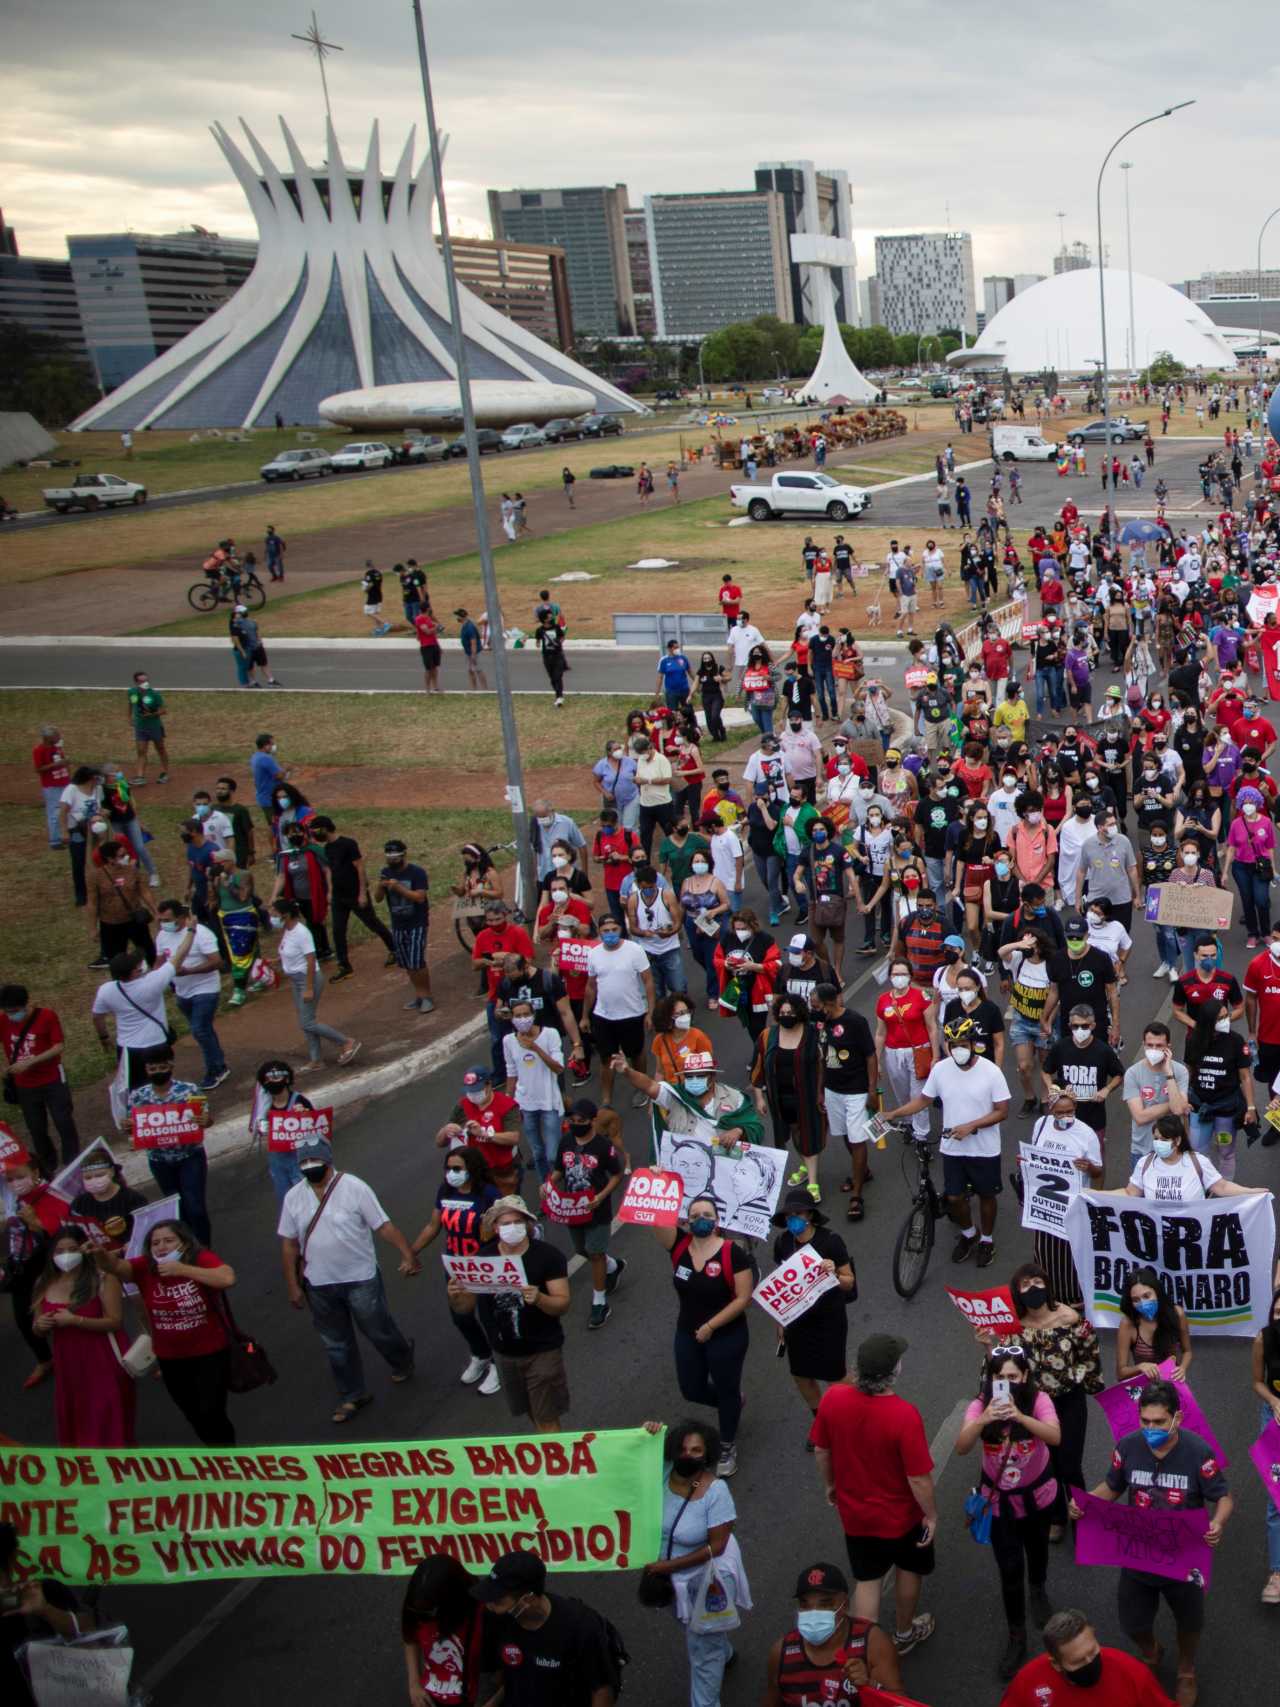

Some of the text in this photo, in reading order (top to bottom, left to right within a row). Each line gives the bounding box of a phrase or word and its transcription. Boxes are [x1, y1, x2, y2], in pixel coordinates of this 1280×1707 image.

[561, 942, 592, 956] FOR
[1062, 1064, 1097, 1086] FORA
[135, 1108, 196, 1128] FORA
[272, 1113, 329, 1132] FORA
[136, 1123, 199, 1138] BOLSONARO
[1029, 1163, 1075, 1175] BOLSONARO
[1030, 1153, 1073, 1169] FORA
[628, 1176, 680, 1199] FORA
[1036, 1173, 1070, 1205] 2
[1031, 1196, 1067, 1213] OUTUBR
[634, 1211, 656, 1222] CUT
[744, 1214, 766, 1226] FORA
[1087, 1202, 1250, 1271] FORA
[450, 1256, 517, 1273] NÃO À
[497, 1273, 522, 1286] 32
[759, 1252, 816, 1302] NÃO À
[769, 1264, 825, 1310] PEC 32
[55, 1455, 99, 1487] DE
[105, 1455, 308, 1484] MULHERES
[314, 1448, 455, 1481] NEGRAS
[464, 1432, 598, 1478] BAOBÁ
[391, 1487, 544, 1527] EXIGEM
[82, 1533, 141, 1581] ÀS
[152, 1532, 305, 1574] VÍTIMAS
[319, 1532, 367, 1572] DO
